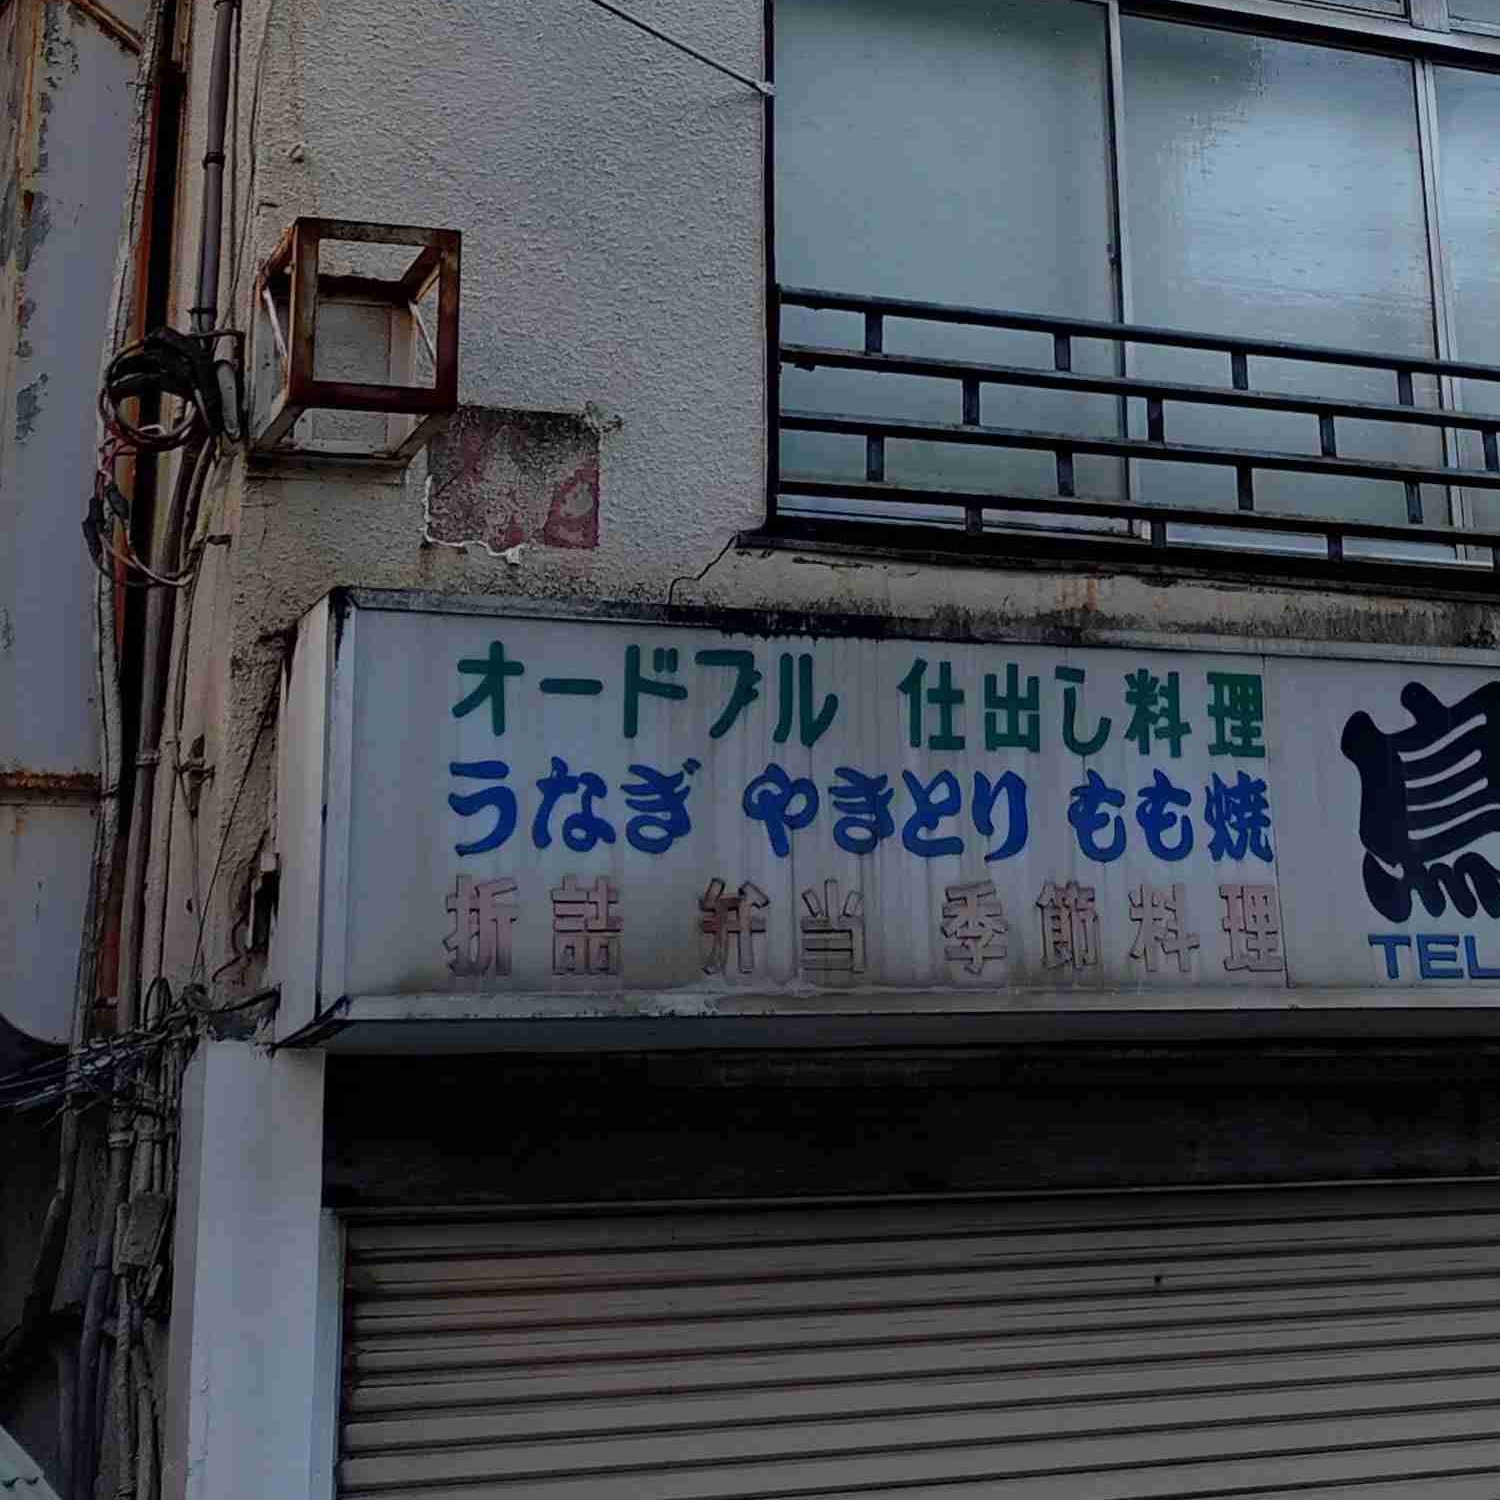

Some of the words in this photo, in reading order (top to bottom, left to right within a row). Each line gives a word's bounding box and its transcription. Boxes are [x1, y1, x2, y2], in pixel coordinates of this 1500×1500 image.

[451, 640, 839, 748] オードブル
[897, 657, 1266, 758] 仕出し料理
[448, 755, 702, 857] うなぎ
[742, 762, 1029, 863] やきとり
[1066, 767, 1274, 863] もも焼
[441, 873, 624, 977] 折詰
[700, 876, 866, 976] 弁当
[940, 879, 1284, 975] 季節料理
